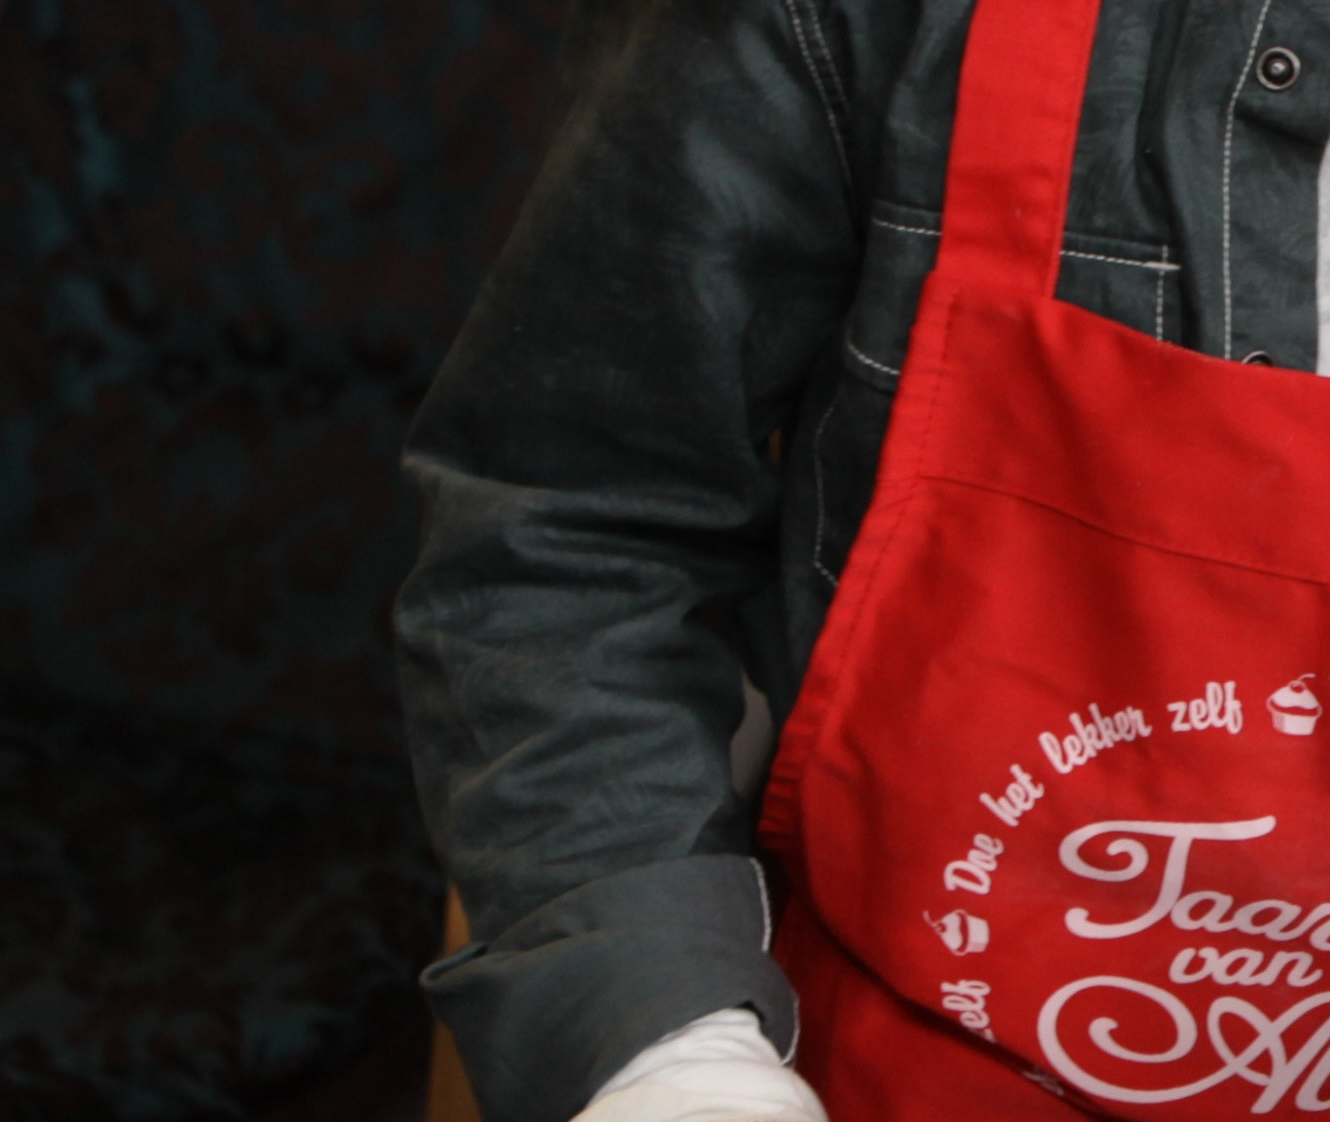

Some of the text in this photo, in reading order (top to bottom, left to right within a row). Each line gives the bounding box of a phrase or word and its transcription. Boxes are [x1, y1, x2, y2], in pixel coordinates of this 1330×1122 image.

[943, 680, 1244, 896] Doe het lekker zelf
[1169, 946, 1323, 988] van
